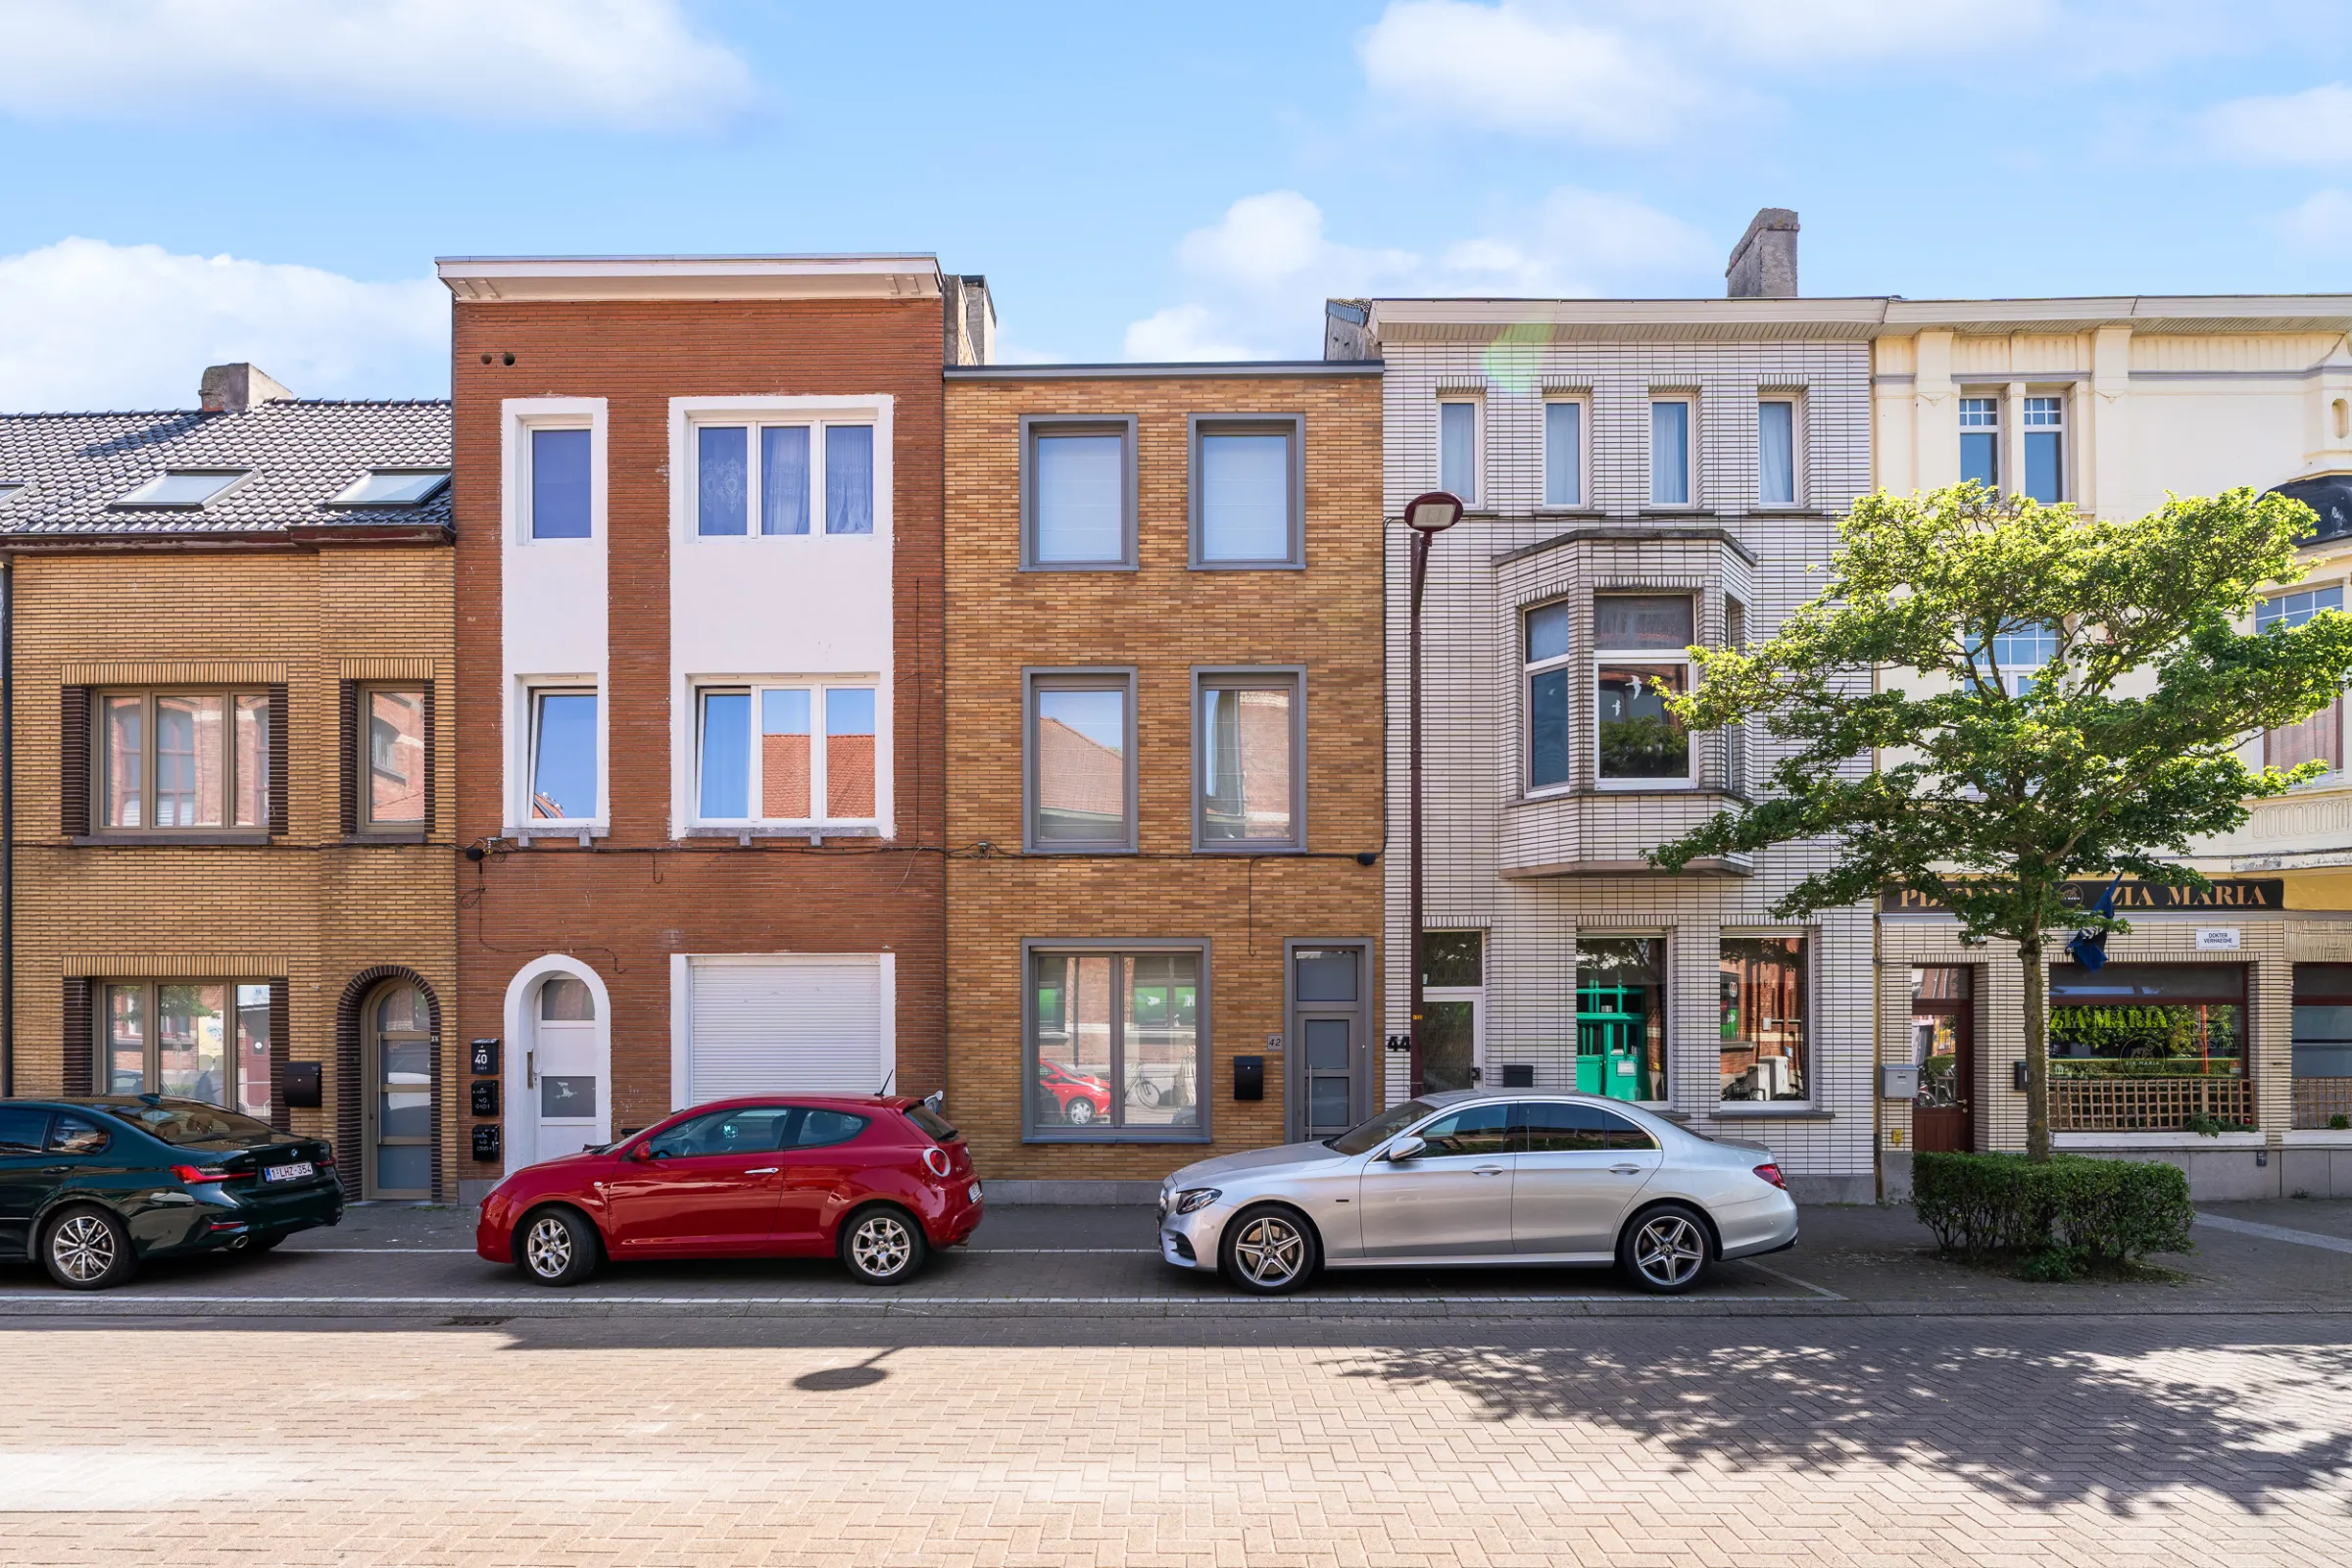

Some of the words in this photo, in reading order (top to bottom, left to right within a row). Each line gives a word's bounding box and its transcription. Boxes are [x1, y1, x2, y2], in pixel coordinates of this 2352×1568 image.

[2106, 886, 2155, 906] ZIA
[2167, 885, 2267, 906] MARIA
[2049, 1009, 2086, 1028] ZIA
[2094, 1008, 2169, 1028] MARIA
[1269, 1038, 1281, 1047] 42
[1388, 1036, 1411, 1052] 44
[474, 1054, 488, 1065] 40
